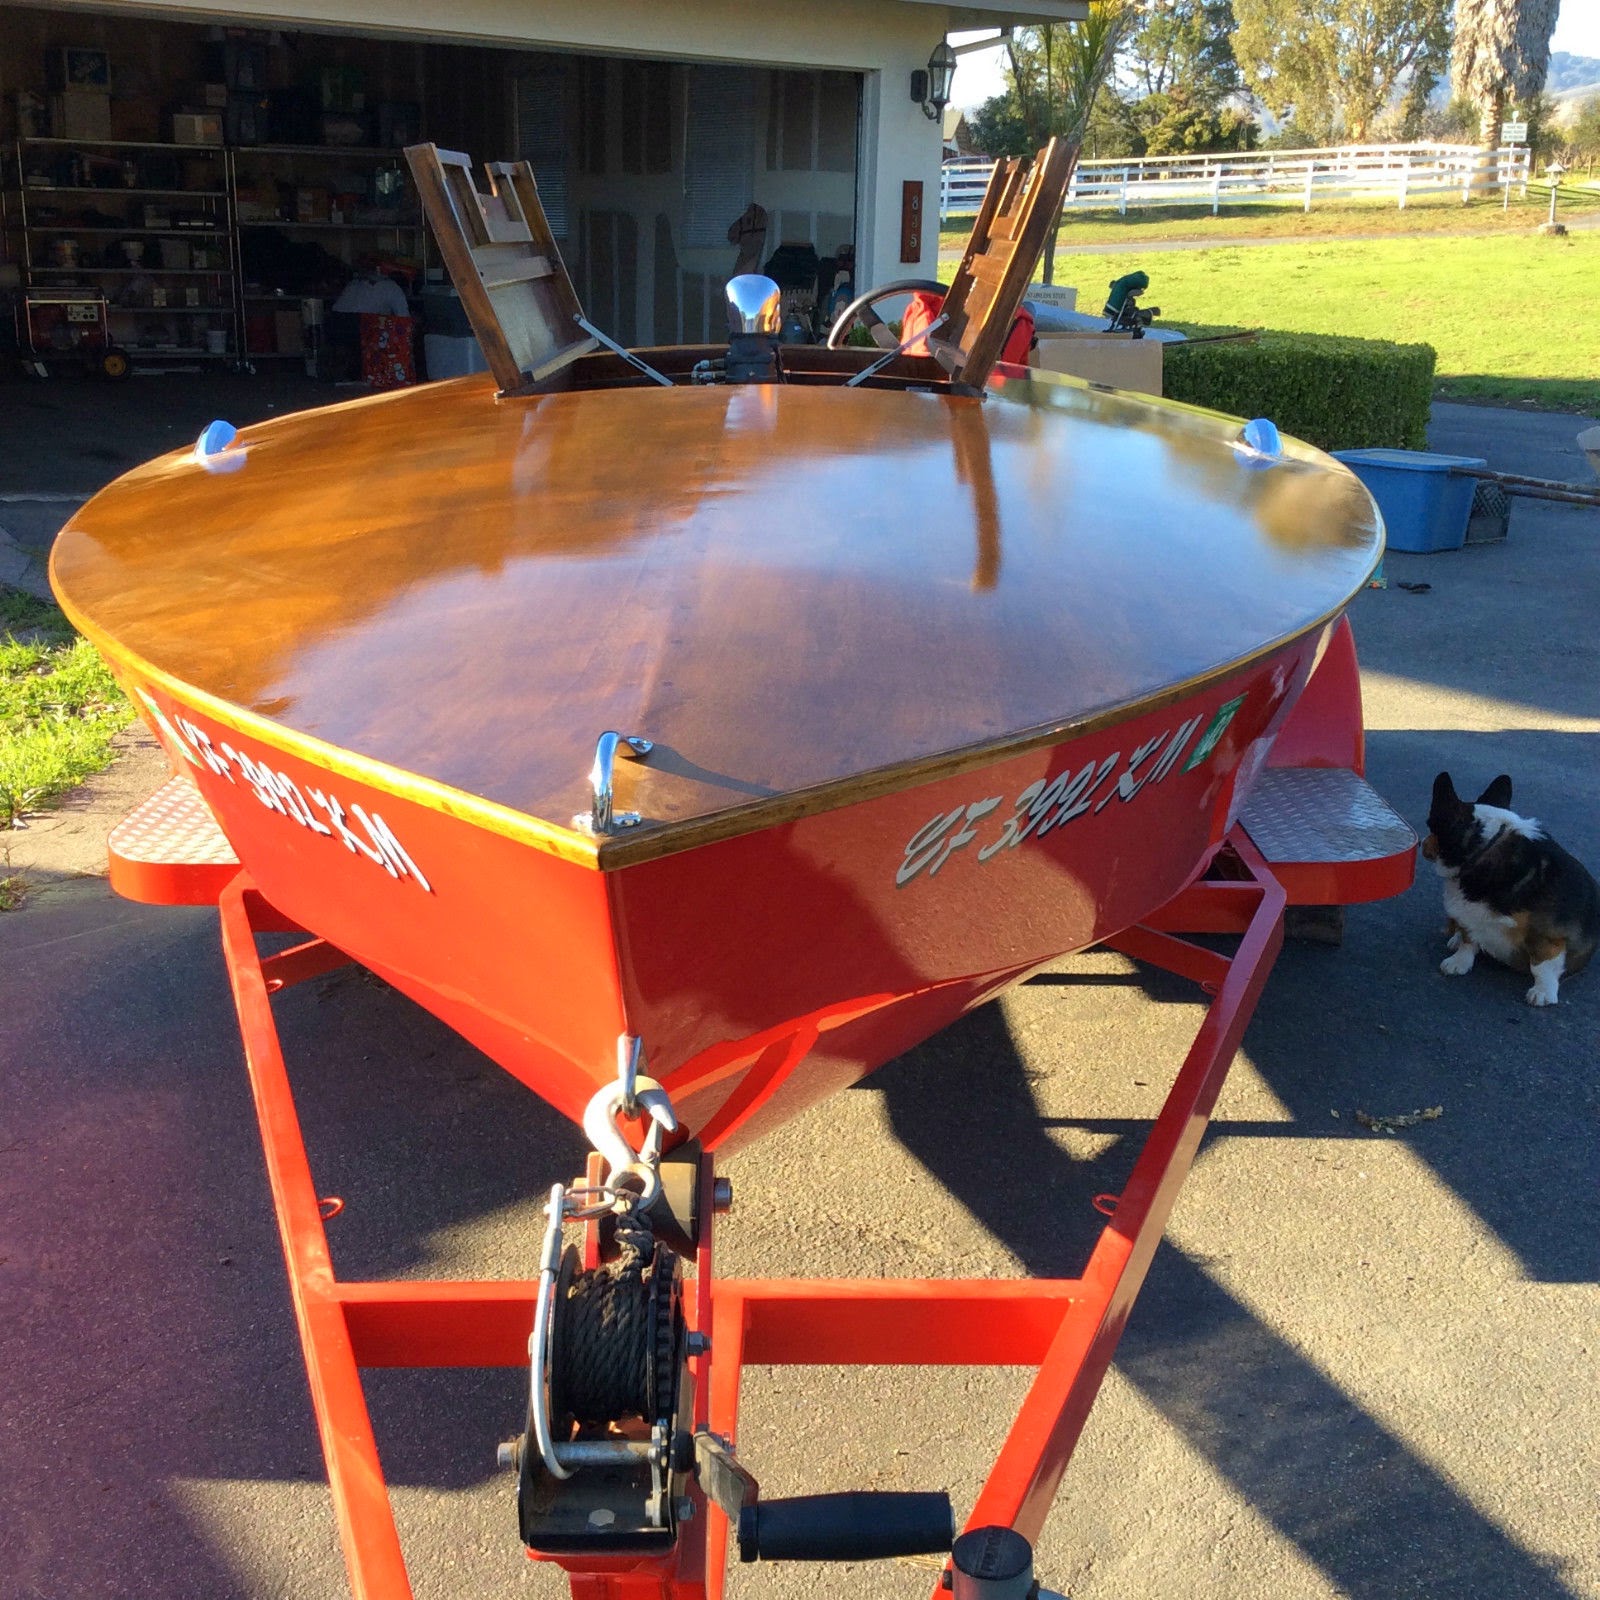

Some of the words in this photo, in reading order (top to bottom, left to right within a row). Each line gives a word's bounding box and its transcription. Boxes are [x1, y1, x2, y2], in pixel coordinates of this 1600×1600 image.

[220, 742, 332, 836] 3992
[896, 796, 1004, 886] CF
[977, 752, 1120, 862] 3992
